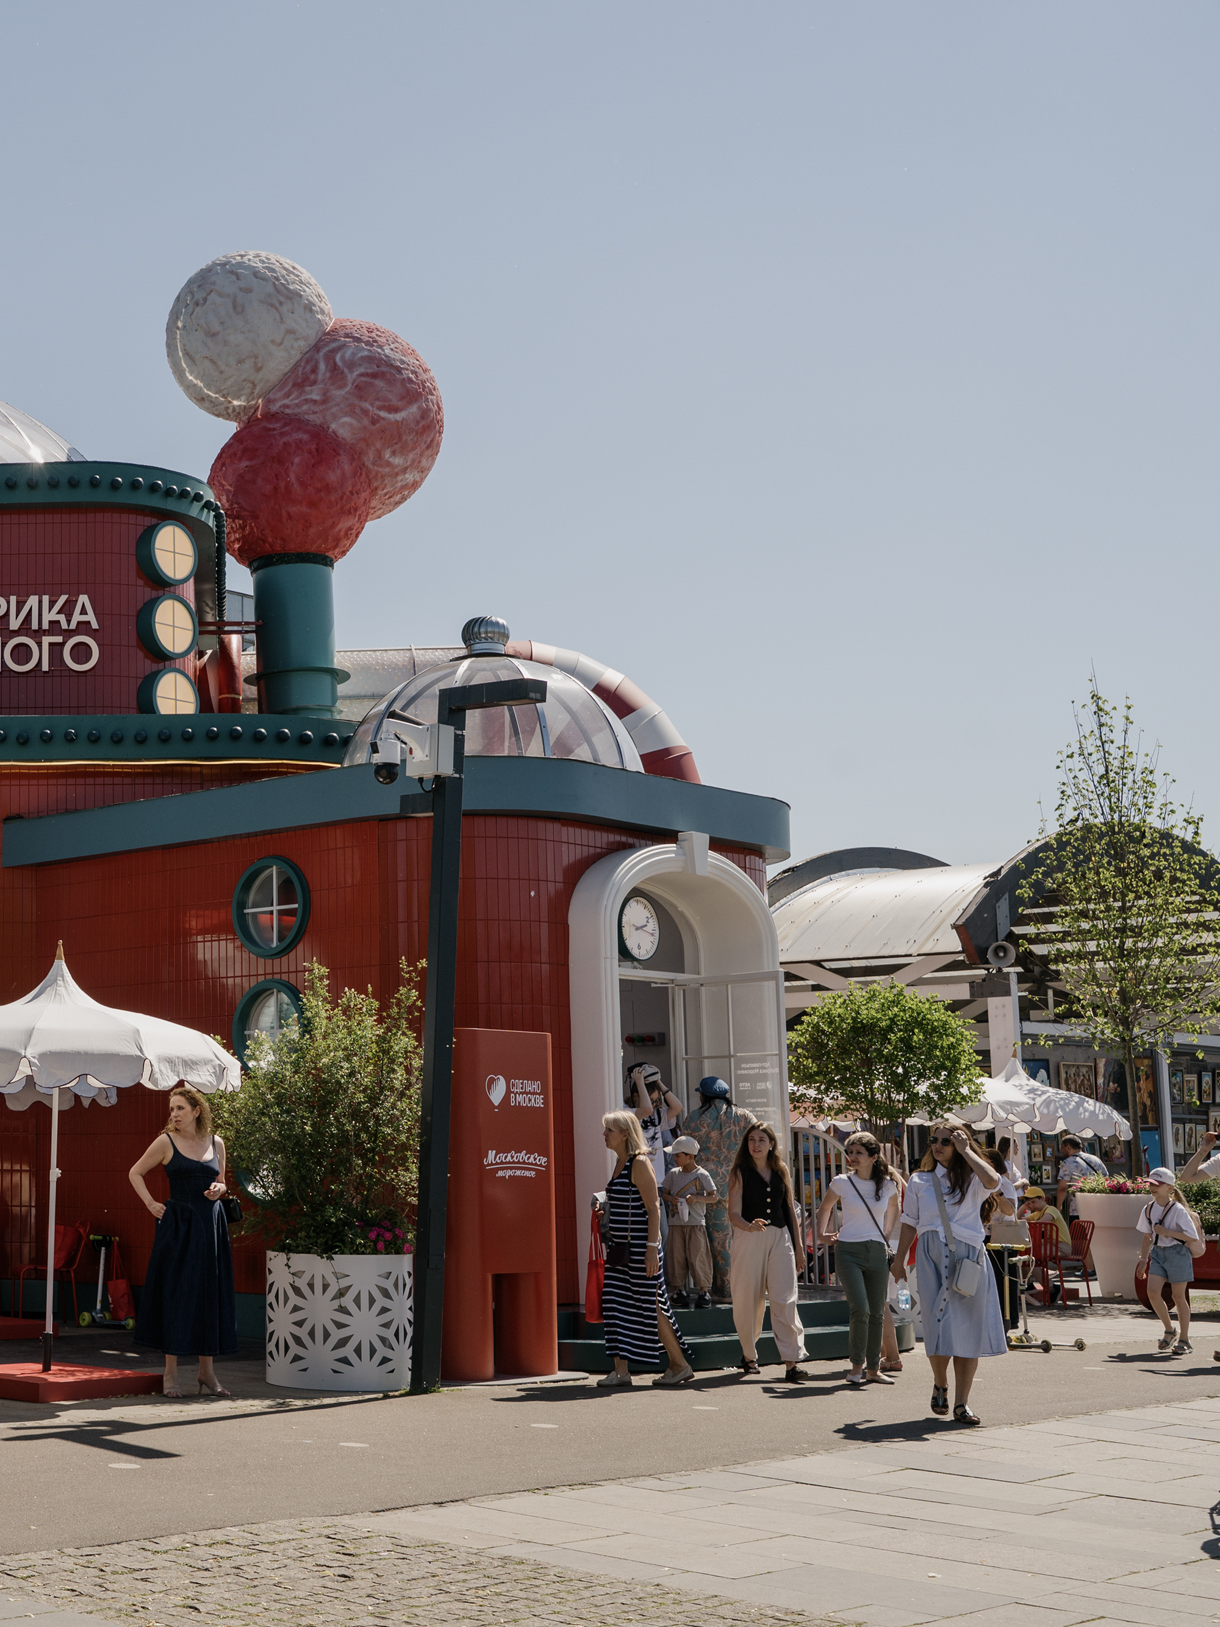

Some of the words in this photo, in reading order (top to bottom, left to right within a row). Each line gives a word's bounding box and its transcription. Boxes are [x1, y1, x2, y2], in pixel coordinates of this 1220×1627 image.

[510, 1079, 541, 1093] СДЕЛАНО
[510, 1094, 515, 1106] В
[516, 1094, 544, 1107] МОСКВЕ
[483, 1150, 548, 1166] Московское
[496, 1169, 536, 1179] мороженое
